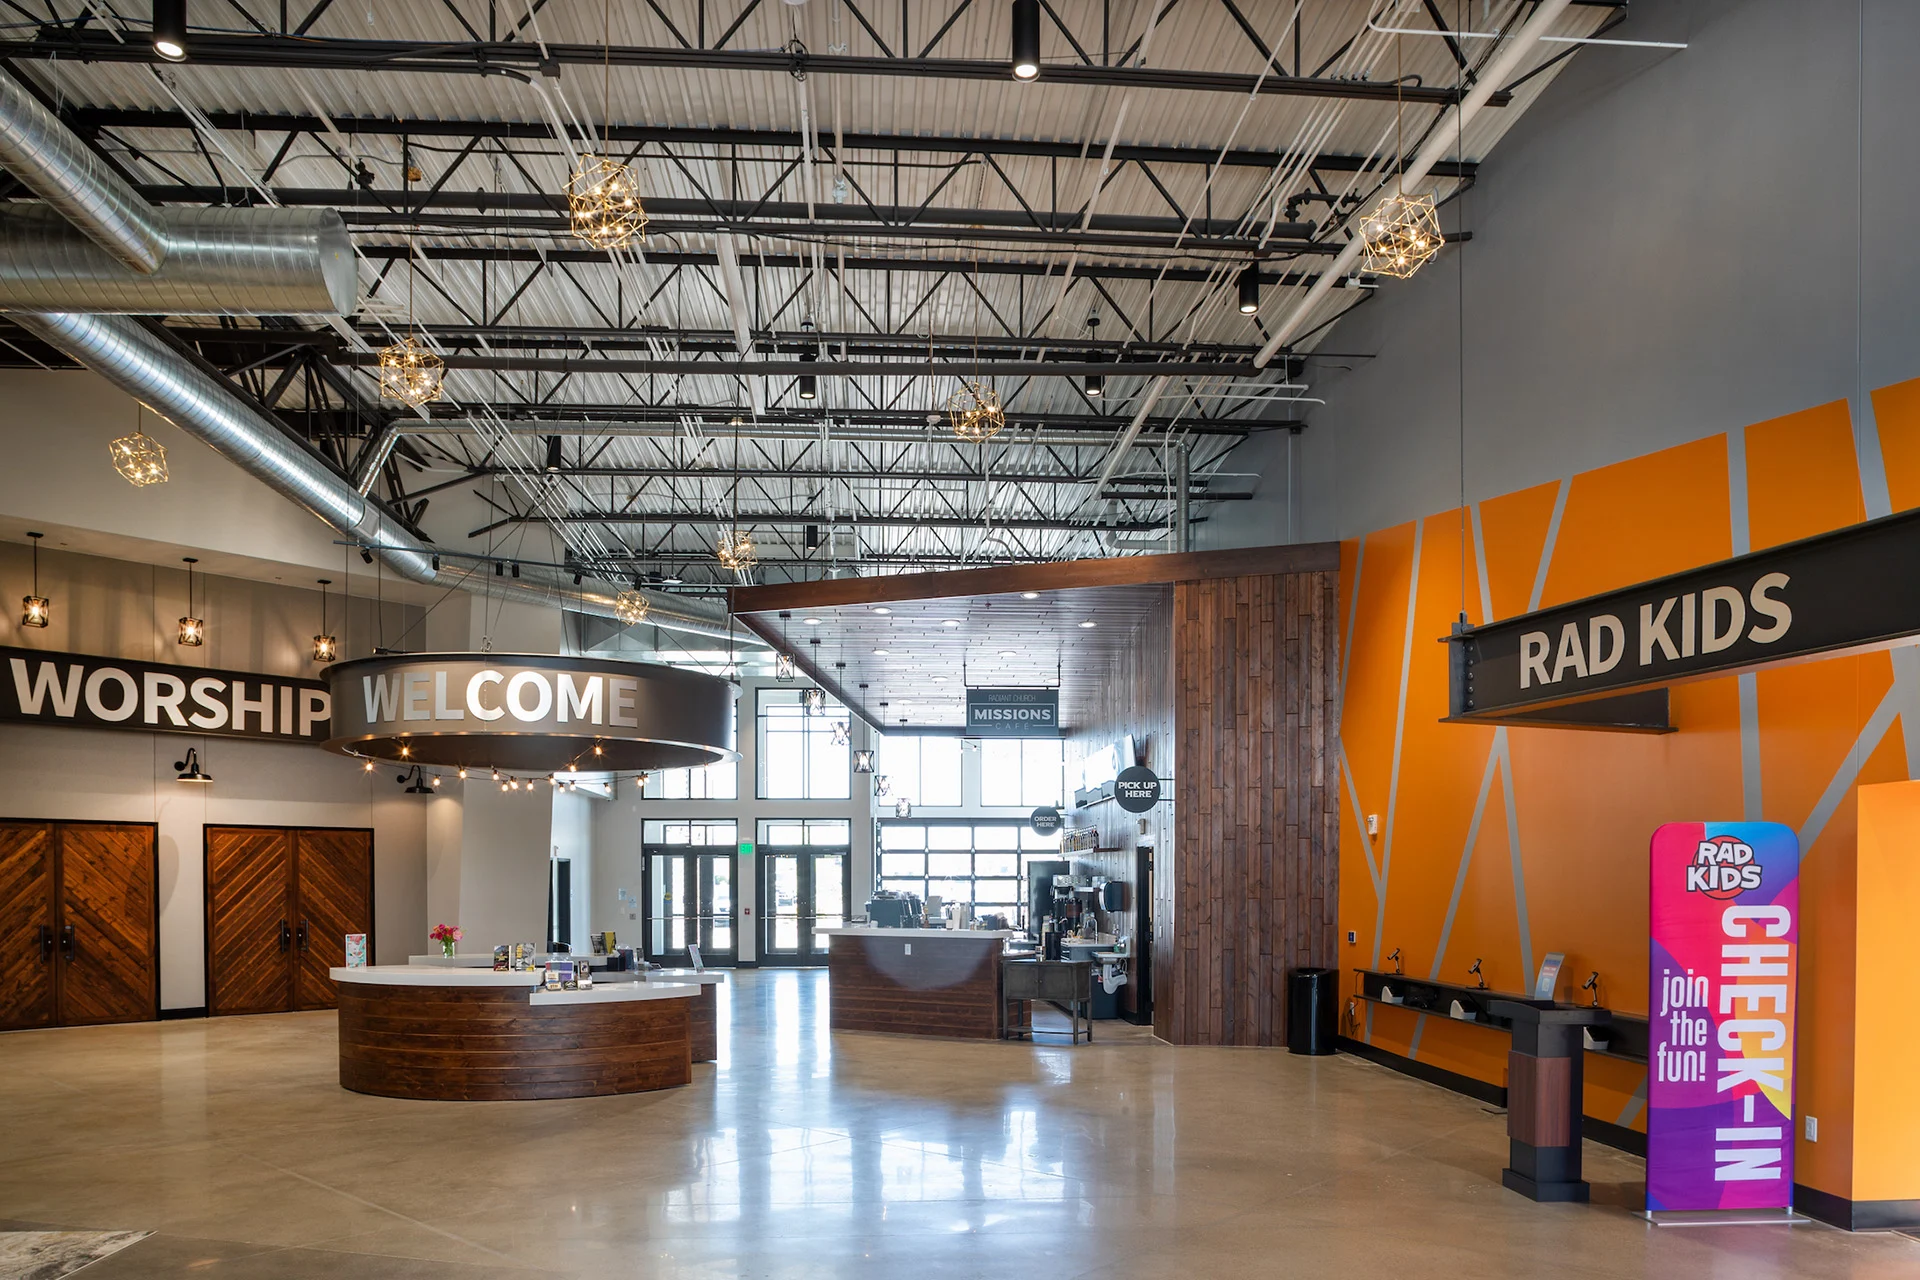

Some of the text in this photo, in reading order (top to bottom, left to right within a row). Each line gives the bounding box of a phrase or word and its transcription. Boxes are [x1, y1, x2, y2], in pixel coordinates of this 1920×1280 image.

[1519, 572, 1793, 689] RAD KIDS
[9, 657, 331, 736] WORSHIP
[362, 669, 638, 728] WELCOME
[974, 709, 1051, 720] MISSIONS
[988, 694, 1036, 702] RADIANT CHURCH
[1118, 781, 1157, 789] PICK UP
[1125, 790, 1152, 798] HERE
[1697, 841, 1754, 866] RAD
[1687, 865, 1762, 892] KIDS
[1660, 968, 1709, 1017] join
[1670, 1010, 1708, 1046] the
[1714, 905, 1791, 1181] CHECK-IN
[1657, 1041, 1706, 1082] fun!
